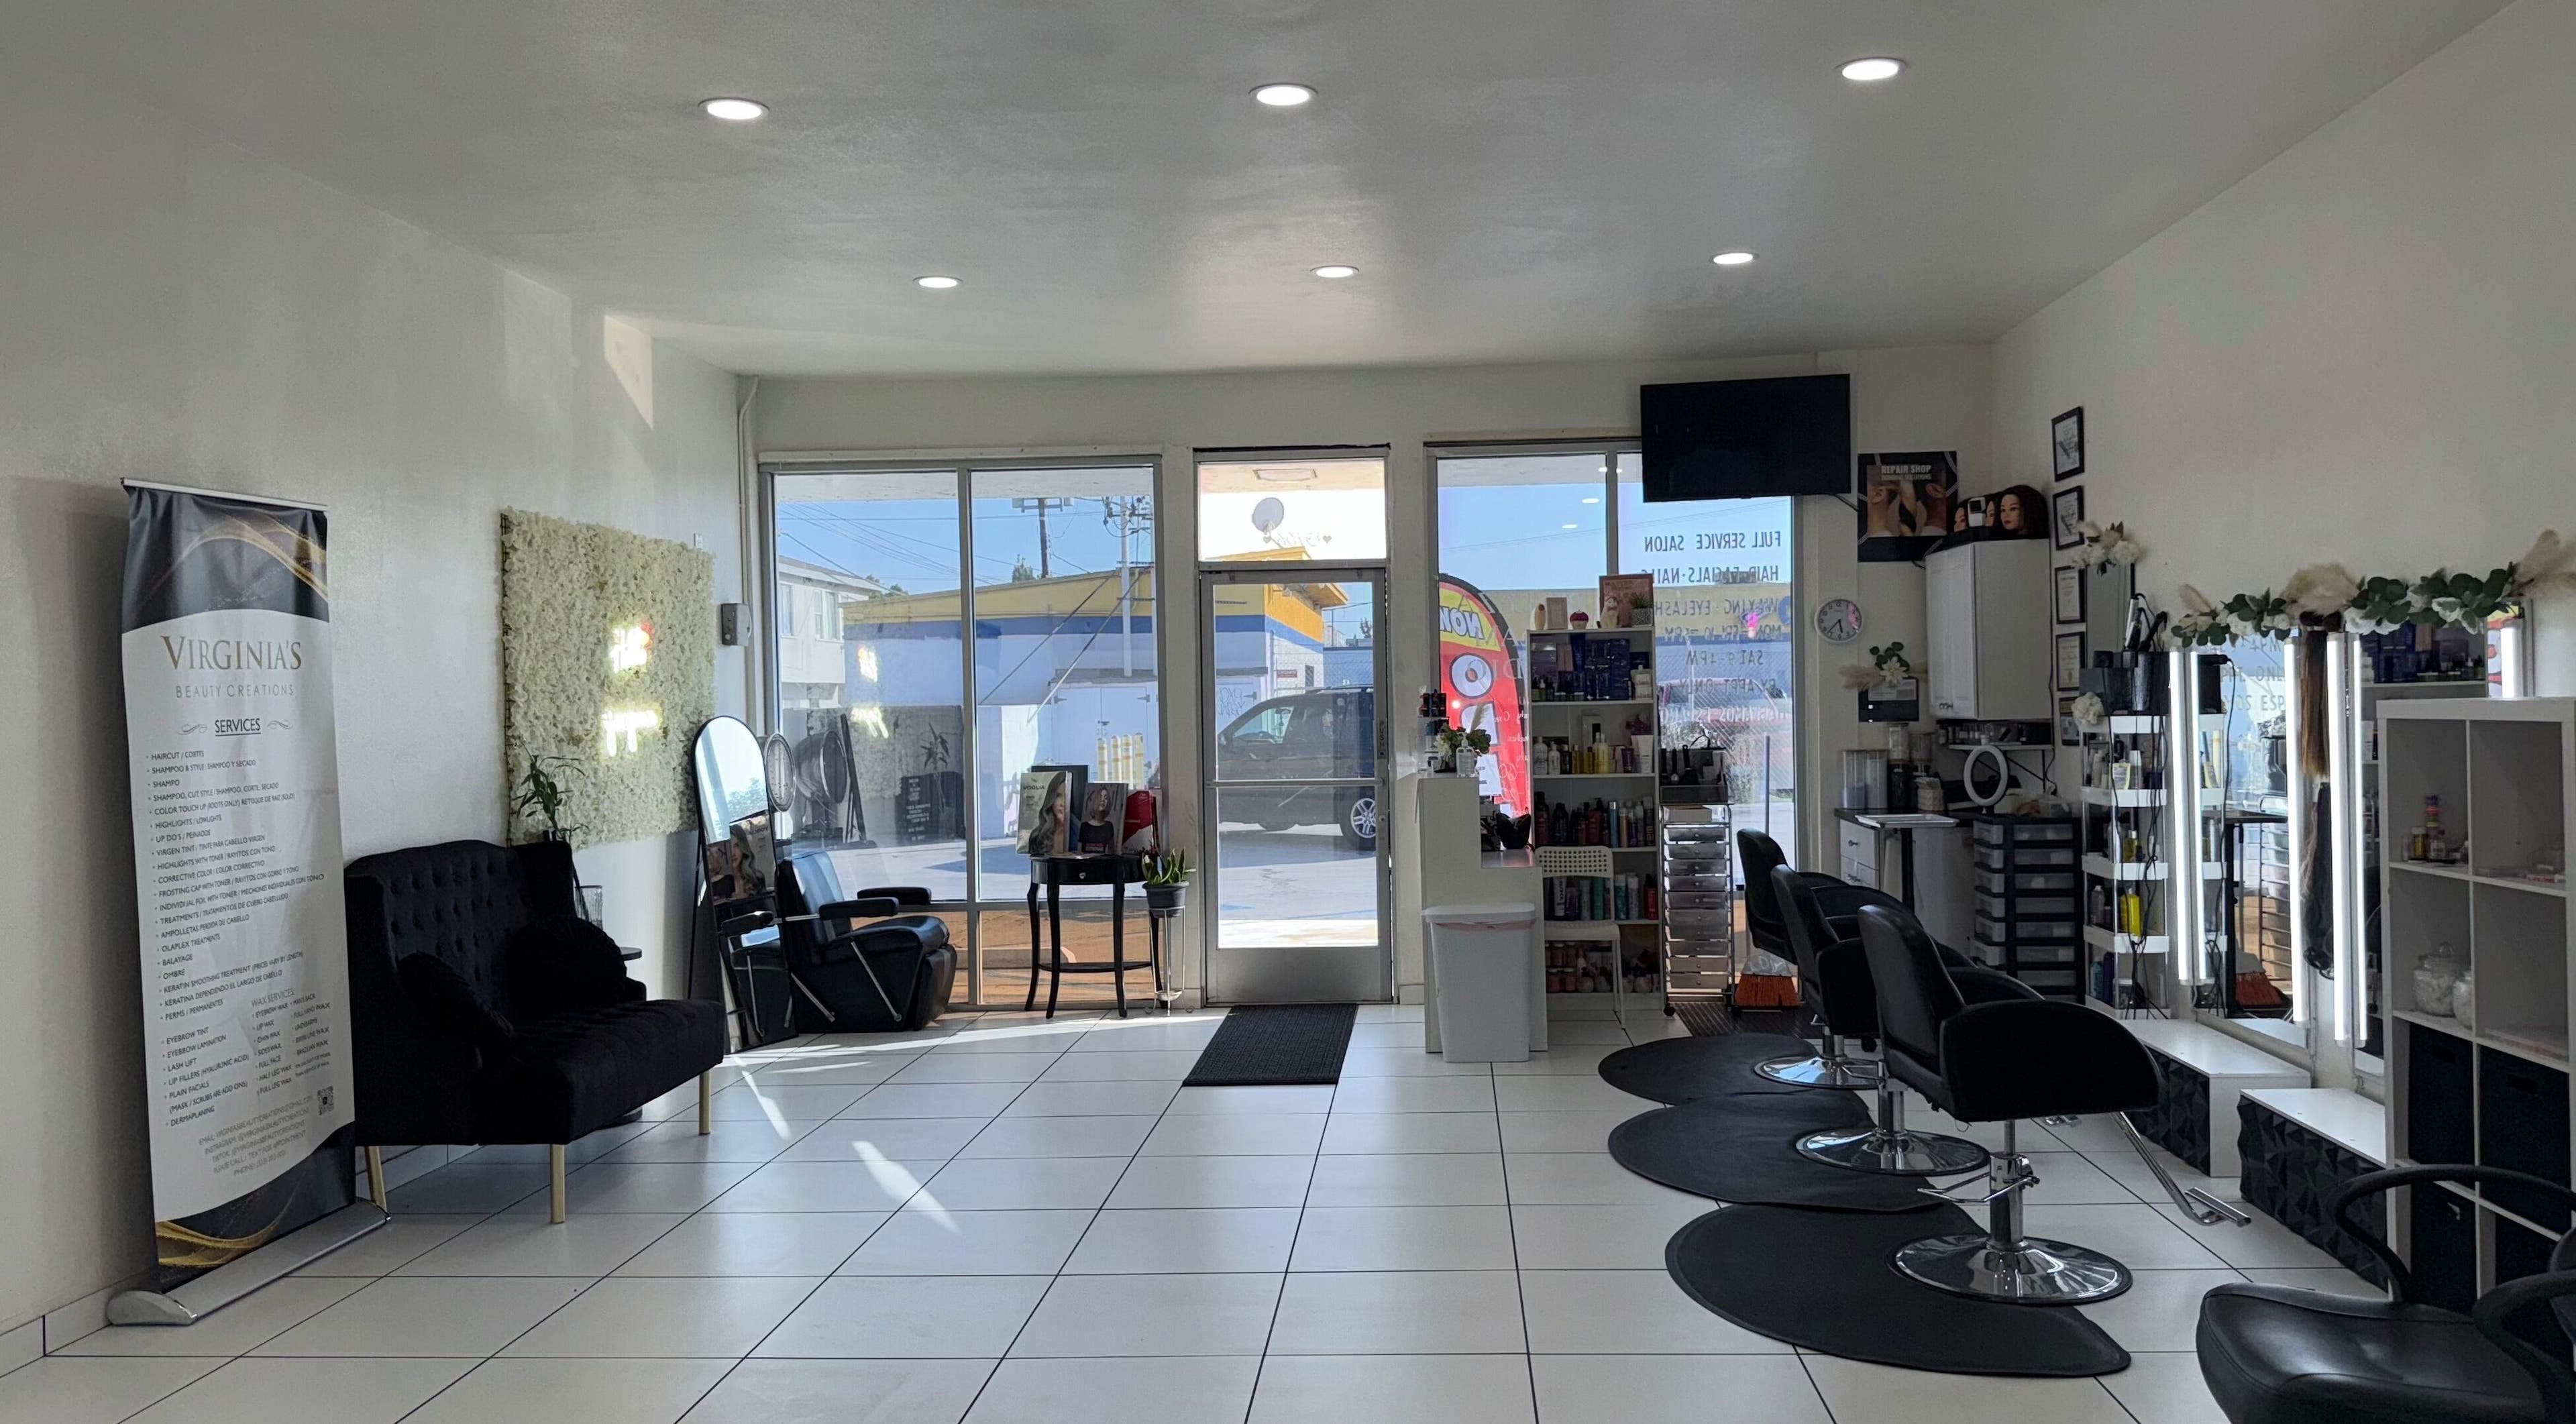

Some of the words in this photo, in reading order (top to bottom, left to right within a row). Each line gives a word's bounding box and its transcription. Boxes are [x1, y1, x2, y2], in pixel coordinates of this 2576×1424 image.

[1881, 465, 1909, 474] REPAIR
[1911, 464, 1931, 474] SHOP
[160, 635, 302, 670] VIRGINIA'S
[176, 684, 221, 698] BEAUTY
[226, 683, 294, 698] CREATIONS
[215, 718, 262, 734] SERVICES
[151, 751, 180, 760] HAIRCUT
[152, 765, 184, 774] SHAMPOO
[154, 806, 178, 815] COLOR
[178, 804, 199, 813] TOUCH
[155, 818, 193, 829] HIGHLIGHTS
[156, 846, 180, 856] VIRGEN
[182, 844, 195, 853] TINT
[224, 836, 248, 846] CABELLO
[157, 859, 195, 870] HIGHLIGHTS
[158, 872, 196, 883] CORRECTIVE
[159, 886, 190, 897] FROSTING
[190, 884, 202, 893] CAP
[160, 899, 195, 911] INDIVIDUAL
[160, 912, 199, 924] TREATMENTS
[162, 941, 190, 952] OLAPLEX
[162, 953, 194, 967] BALAYAGE
[163, 968, 186, 979] OMBRE
[164, 981, 190, 994] KERATIN
[164, 994, 195, 1007] KERATINA
[251, 995, 267, 1007] WAX
[267, 987, 295, 1003] SERVICES
[165, 1009, 185, 1020] PERMS
[166, 1030, 196, 1045] EYEBROW
[168, 1061, 184, 1072] LASH
[184, 1058, 197, 1067] LIFT
[168, 1076, 178, 1085] LIP
[169, 1087, 187, 1099] PLAIN
[170, 1105, 215, 1127] DERMAPLANING
